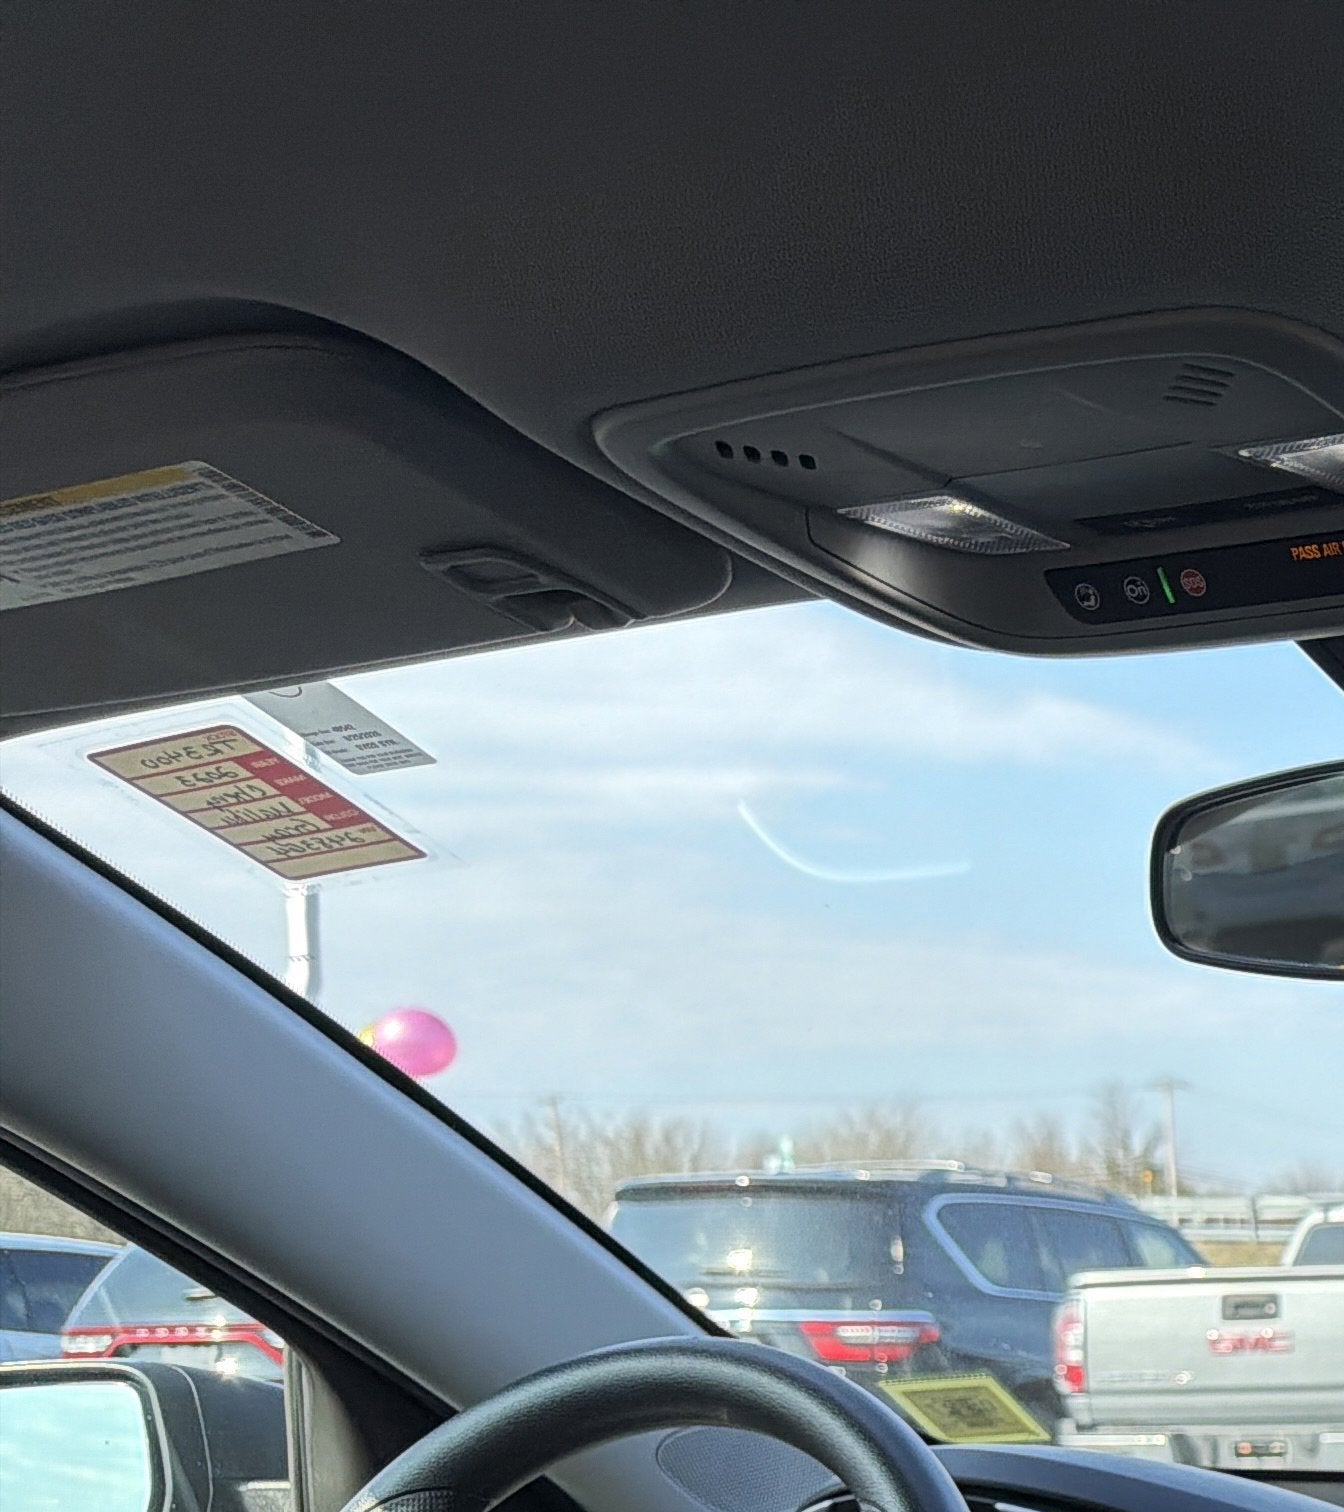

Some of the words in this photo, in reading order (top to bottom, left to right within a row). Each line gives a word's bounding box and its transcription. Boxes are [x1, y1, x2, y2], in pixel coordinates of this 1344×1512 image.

[1290, 544, 1321, 561] PASS
[1323, 541, 1341, 557] AIR
[1182, 571, 1204, 590] SOS
